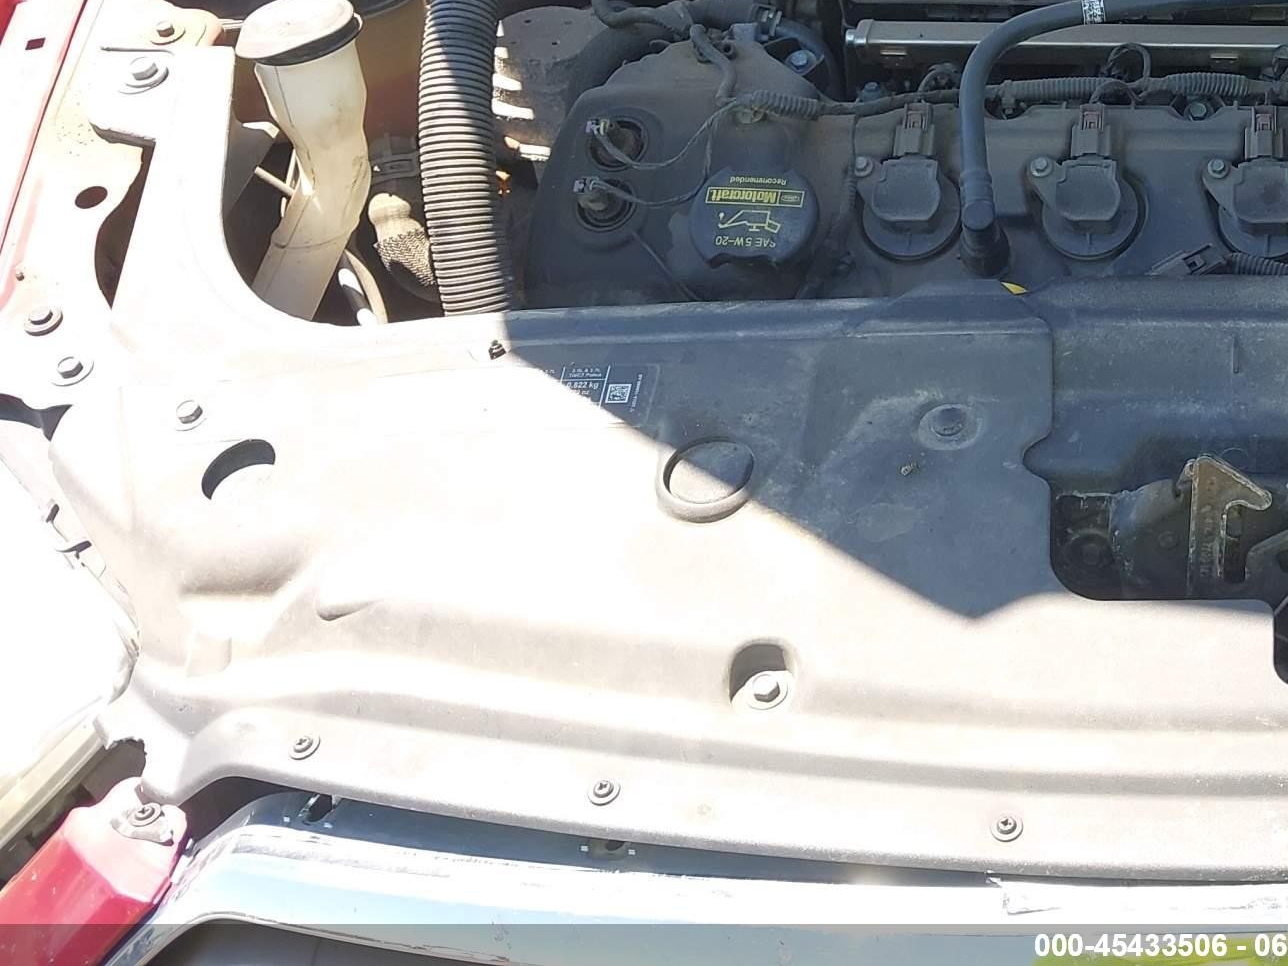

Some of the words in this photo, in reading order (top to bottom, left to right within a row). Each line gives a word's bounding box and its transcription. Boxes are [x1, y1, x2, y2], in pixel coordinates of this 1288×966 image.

[729, 175, 787, 186] Recommended
[711, 188, 777, 203] Motorcraft
[754, 239, 777, 249] SAE
